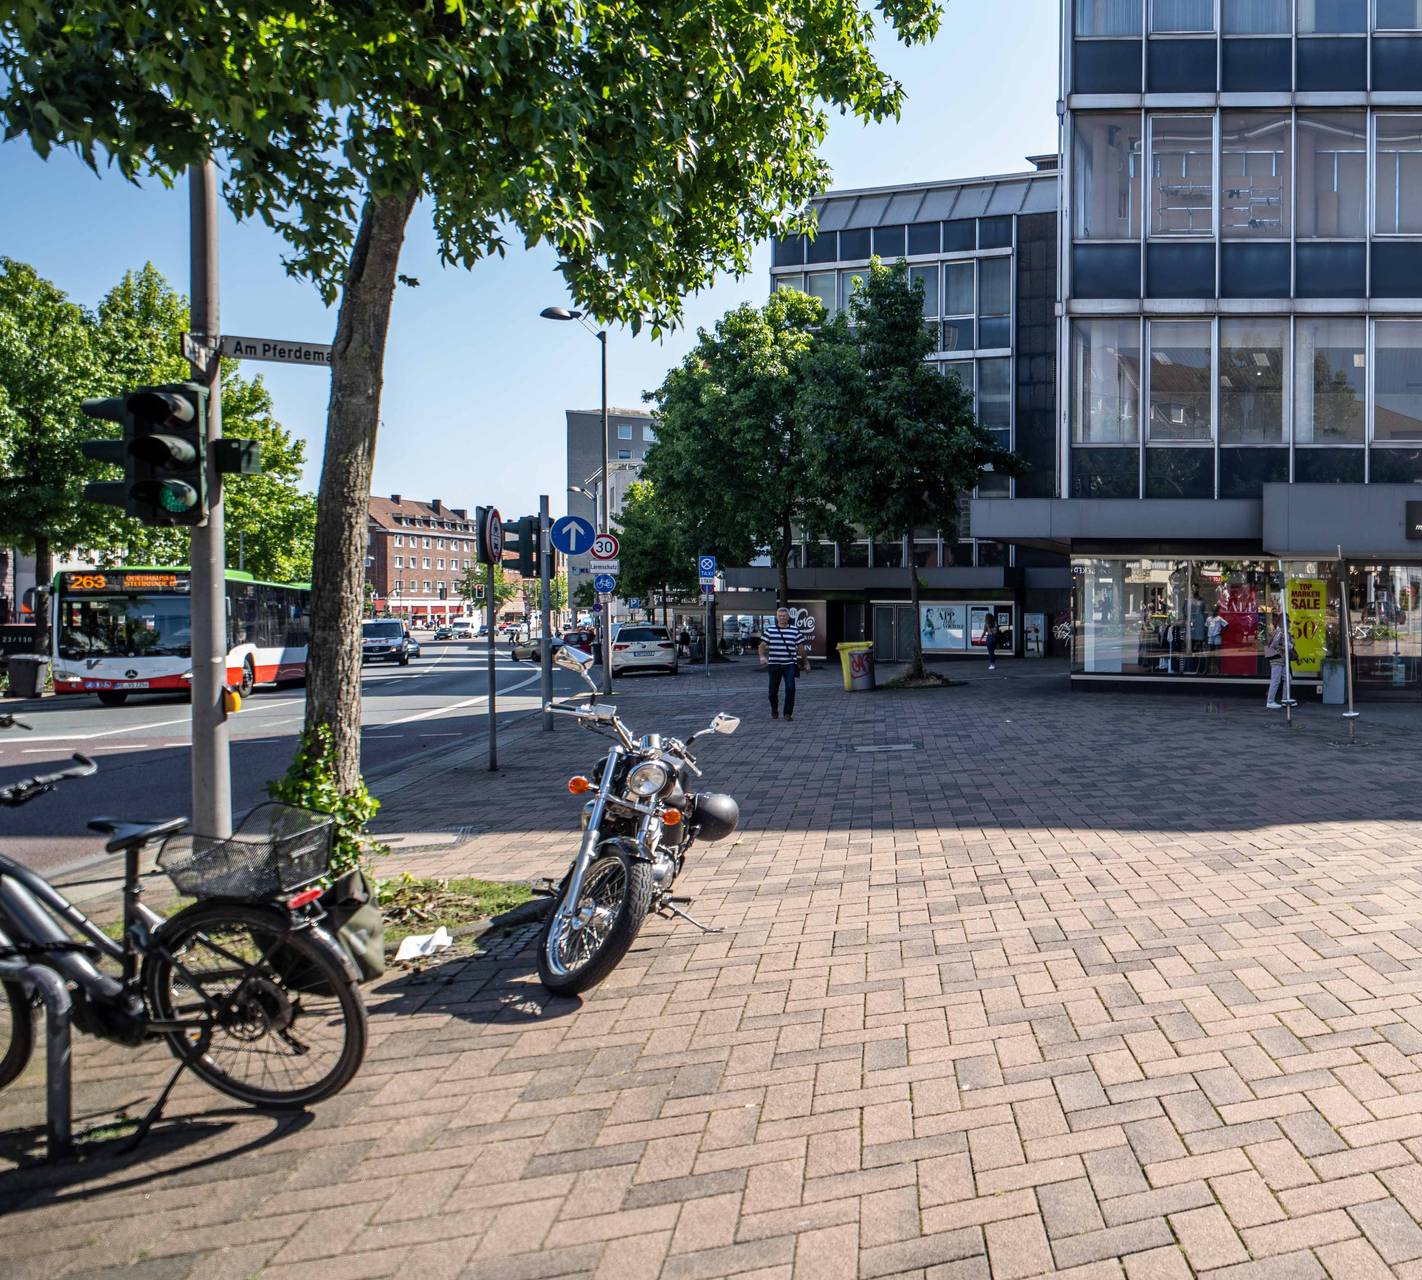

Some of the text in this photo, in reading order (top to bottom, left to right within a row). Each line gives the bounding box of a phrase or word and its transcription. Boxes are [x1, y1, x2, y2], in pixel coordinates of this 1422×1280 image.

[234, 341, 257, 356] Am
[596, 541, 612, 553] 30
[71, 575, 106, 589] 263
[1219, 600, 1257, 613] SALE
[1291, 599, 1320, 609] SALE
